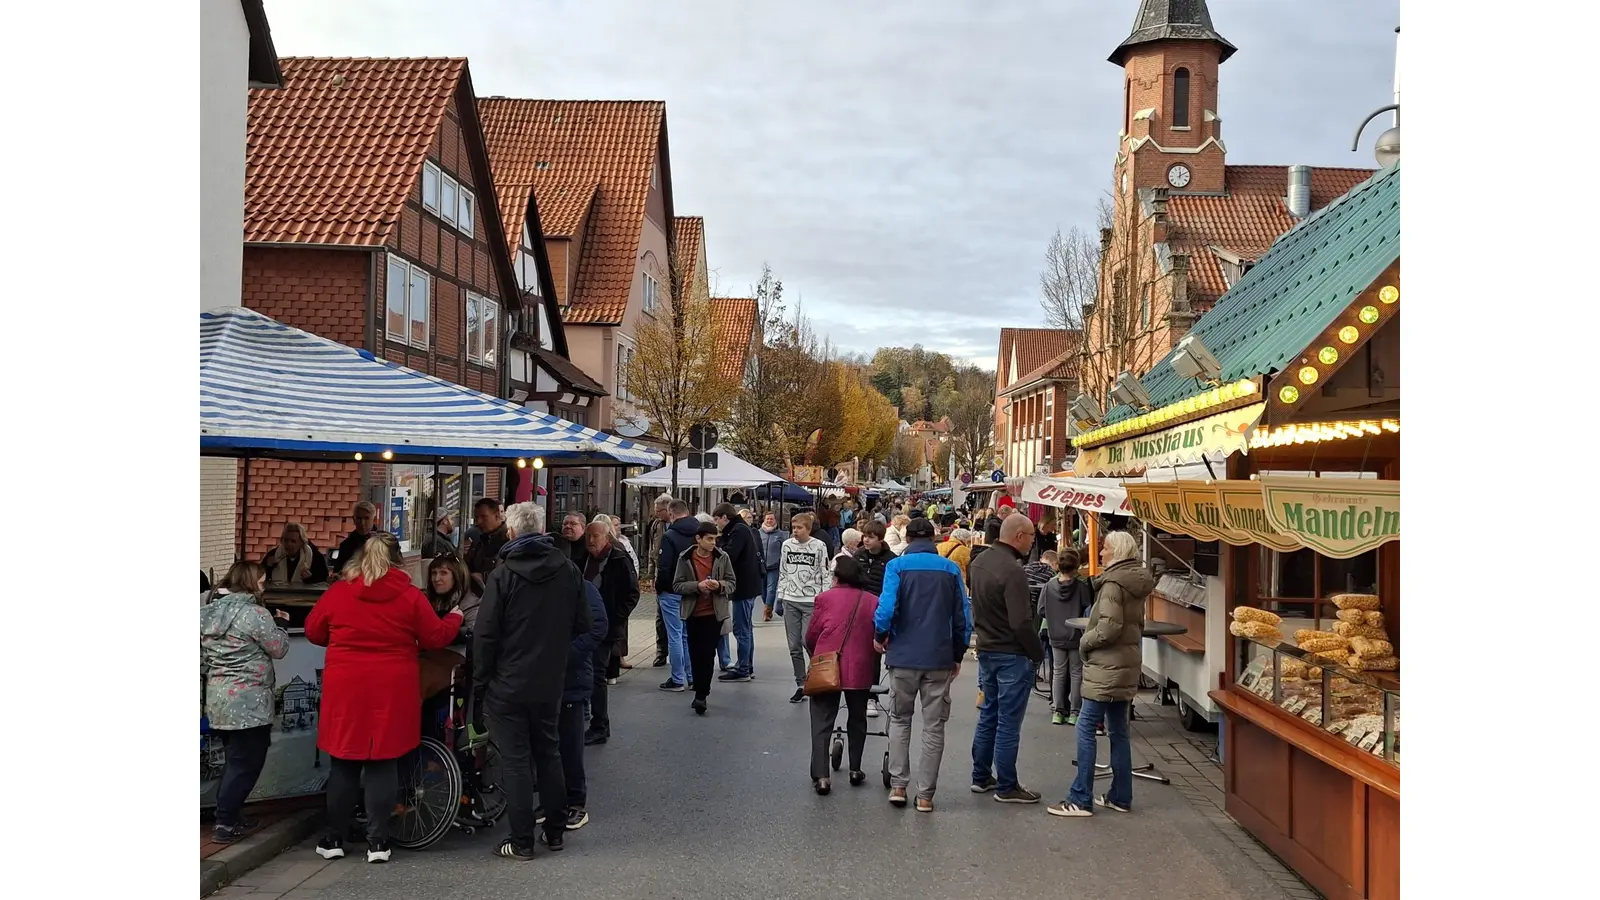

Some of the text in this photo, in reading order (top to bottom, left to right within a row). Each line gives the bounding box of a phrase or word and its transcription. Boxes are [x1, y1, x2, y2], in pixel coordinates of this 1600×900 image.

[1130, 425, 1205, 460] Nusshaus
[1164, 502, 1189, 525] W
[1226, 503, 1277, 534] Sonnen
[1282, 502, 1400, 541] Mandeln
